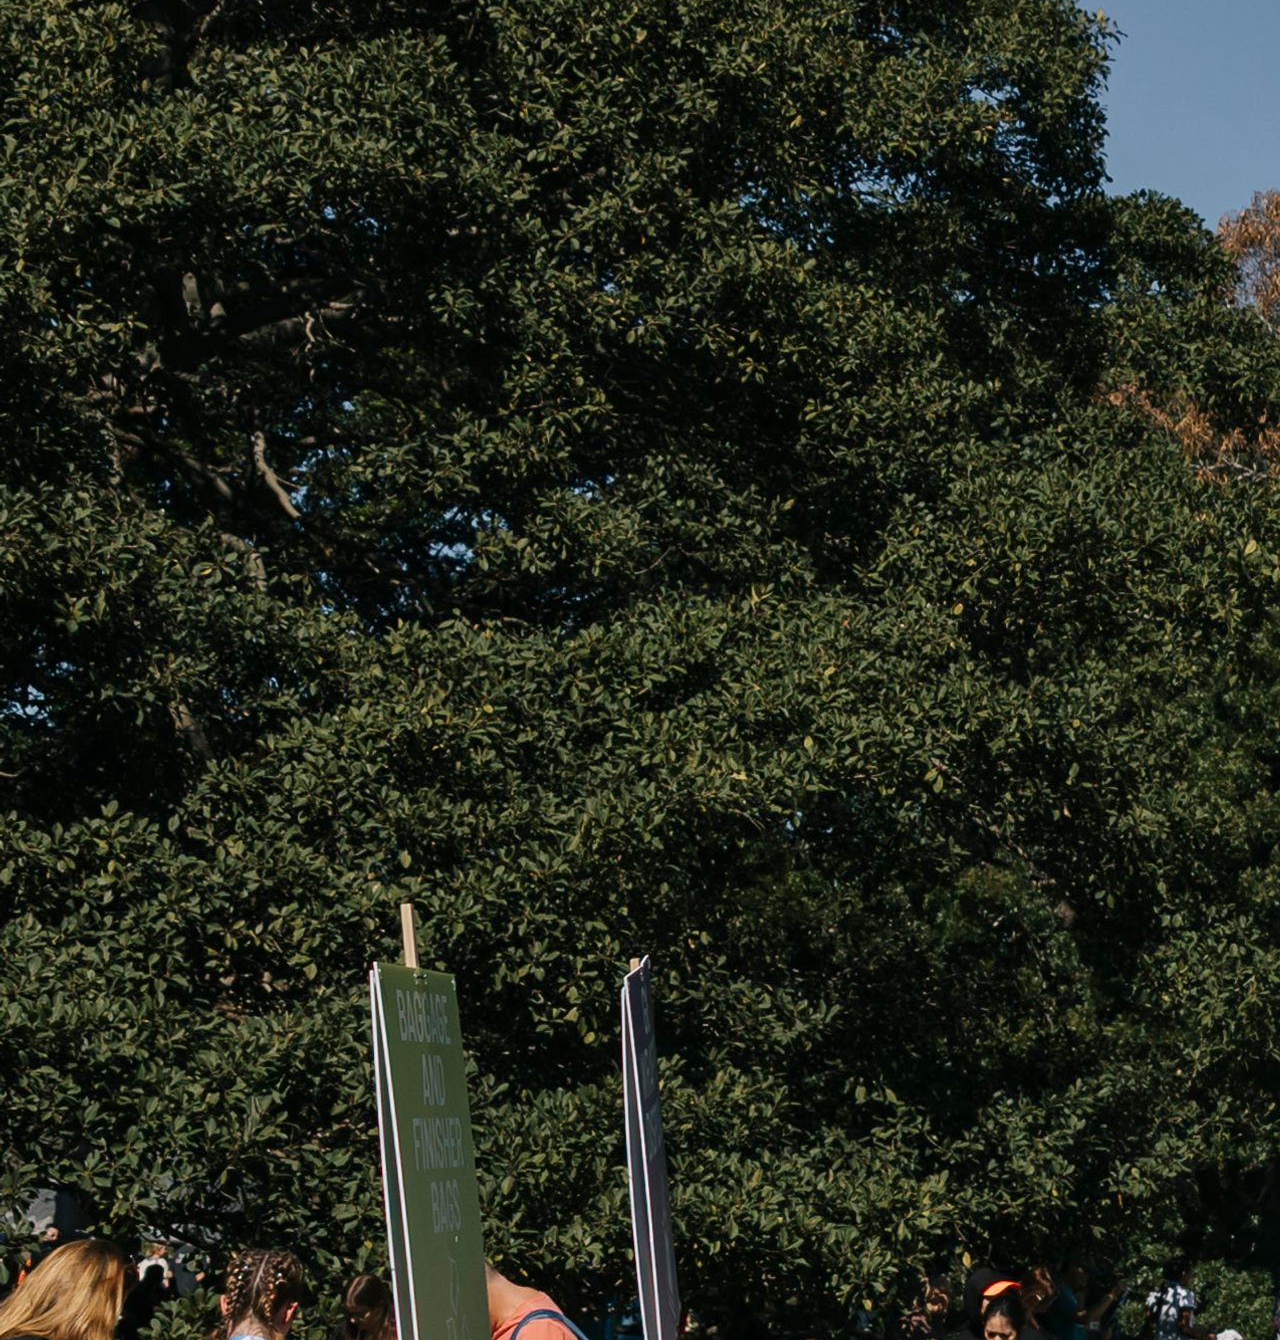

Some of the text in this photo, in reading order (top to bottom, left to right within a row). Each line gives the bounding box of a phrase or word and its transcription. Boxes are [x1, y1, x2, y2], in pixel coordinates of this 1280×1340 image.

[396, 989, 451, 1046] BAGGAGE
[422, 1054, 446, 1107] AND
[412, 1117, 465, 1172] FINISHER
[430, 1181, 462, 1234] BAGS
